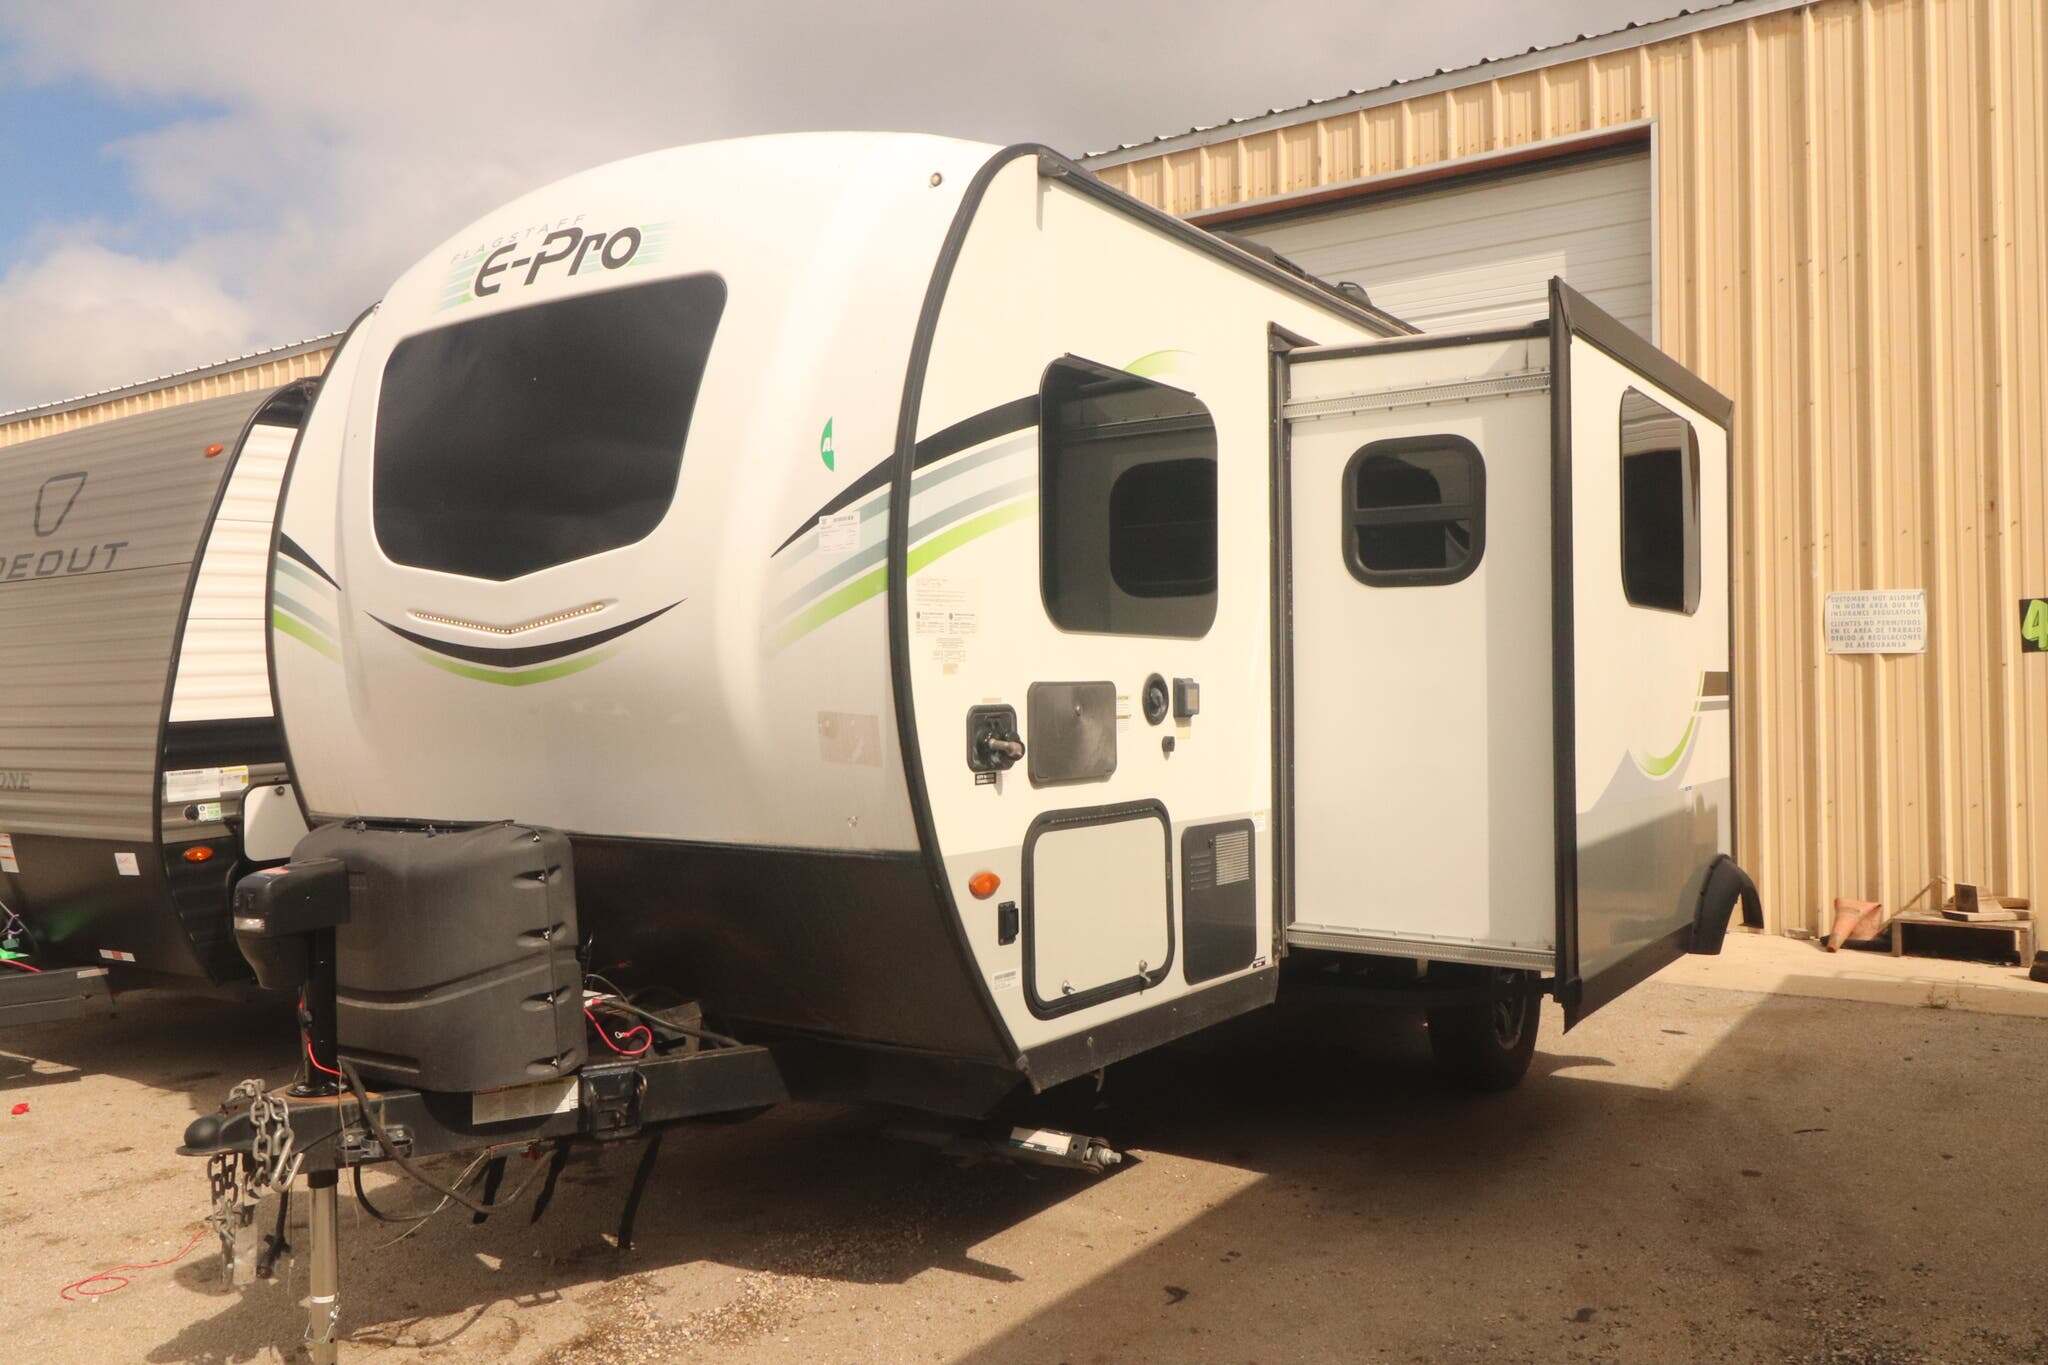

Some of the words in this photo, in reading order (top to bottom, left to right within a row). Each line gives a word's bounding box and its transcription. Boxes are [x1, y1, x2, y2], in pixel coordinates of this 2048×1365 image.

[451, 214, 586, 264] FLAGSTAFF
[0, 541, 129, 579] EOUT
[1831, 594, 1869, 602] CUSTOMERS
[1889, 593, 1922, 601] ALLOWED
[1831, 609, 1869, 617] INSURANCE
[1831, 620, 1862, 628] CLIENTES
[1877, 619, 1921, 627] PERMITIDOS
